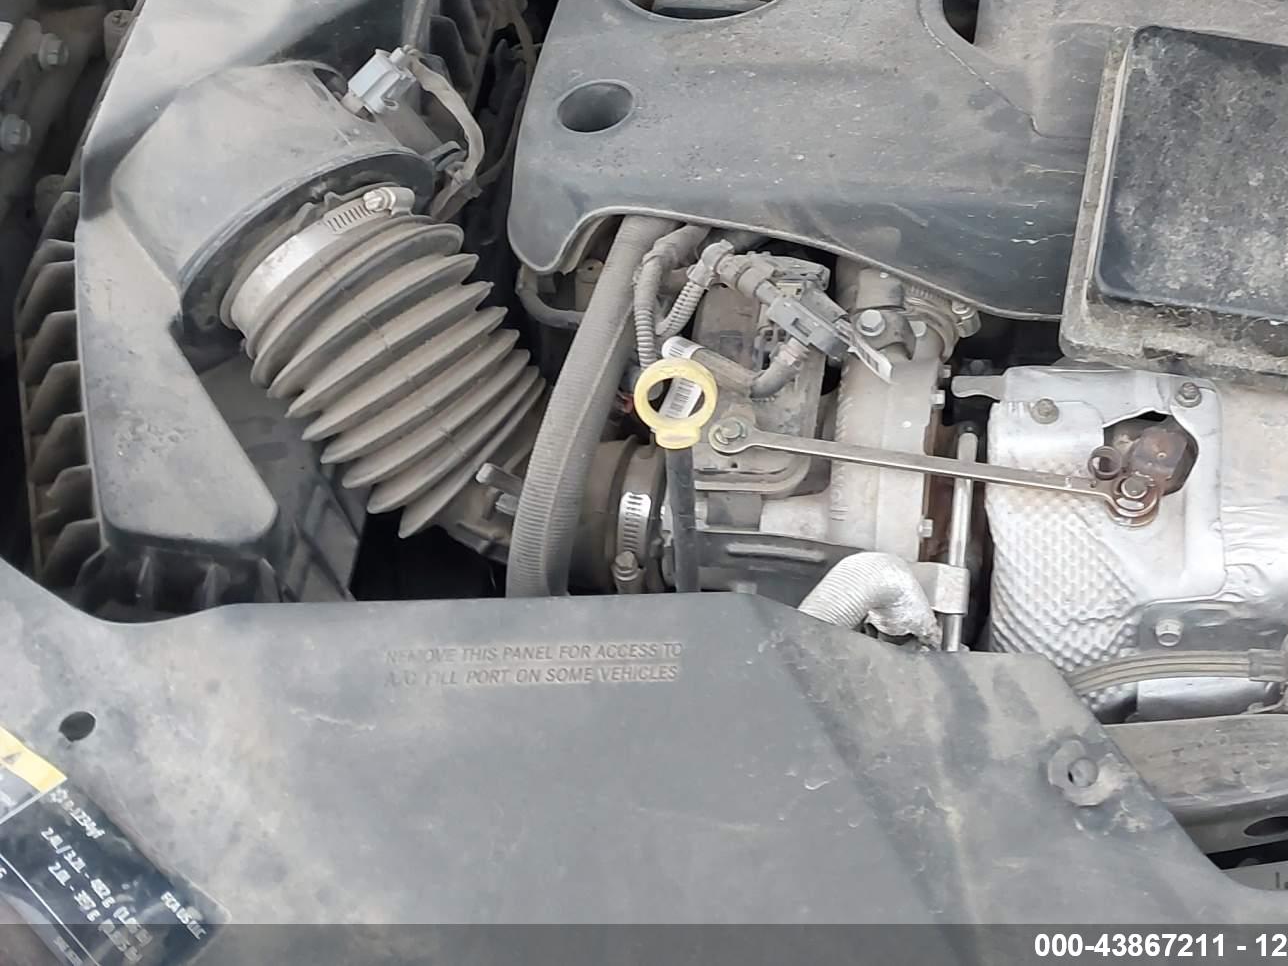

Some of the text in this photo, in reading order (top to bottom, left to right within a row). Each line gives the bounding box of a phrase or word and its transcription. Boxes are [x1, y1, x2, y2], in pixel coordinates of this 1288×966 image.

[384, 641, 683, 667] REMOVE THIS PANEL FOR ACCESS TO
[424, 670, 458, 685] FILL
[466, 669, 511, 684] PORT
[516, 668, 541, 683] ON
[545, 667, 594, 682] SOME
[599, 665, 678, 682] VEHICLES
